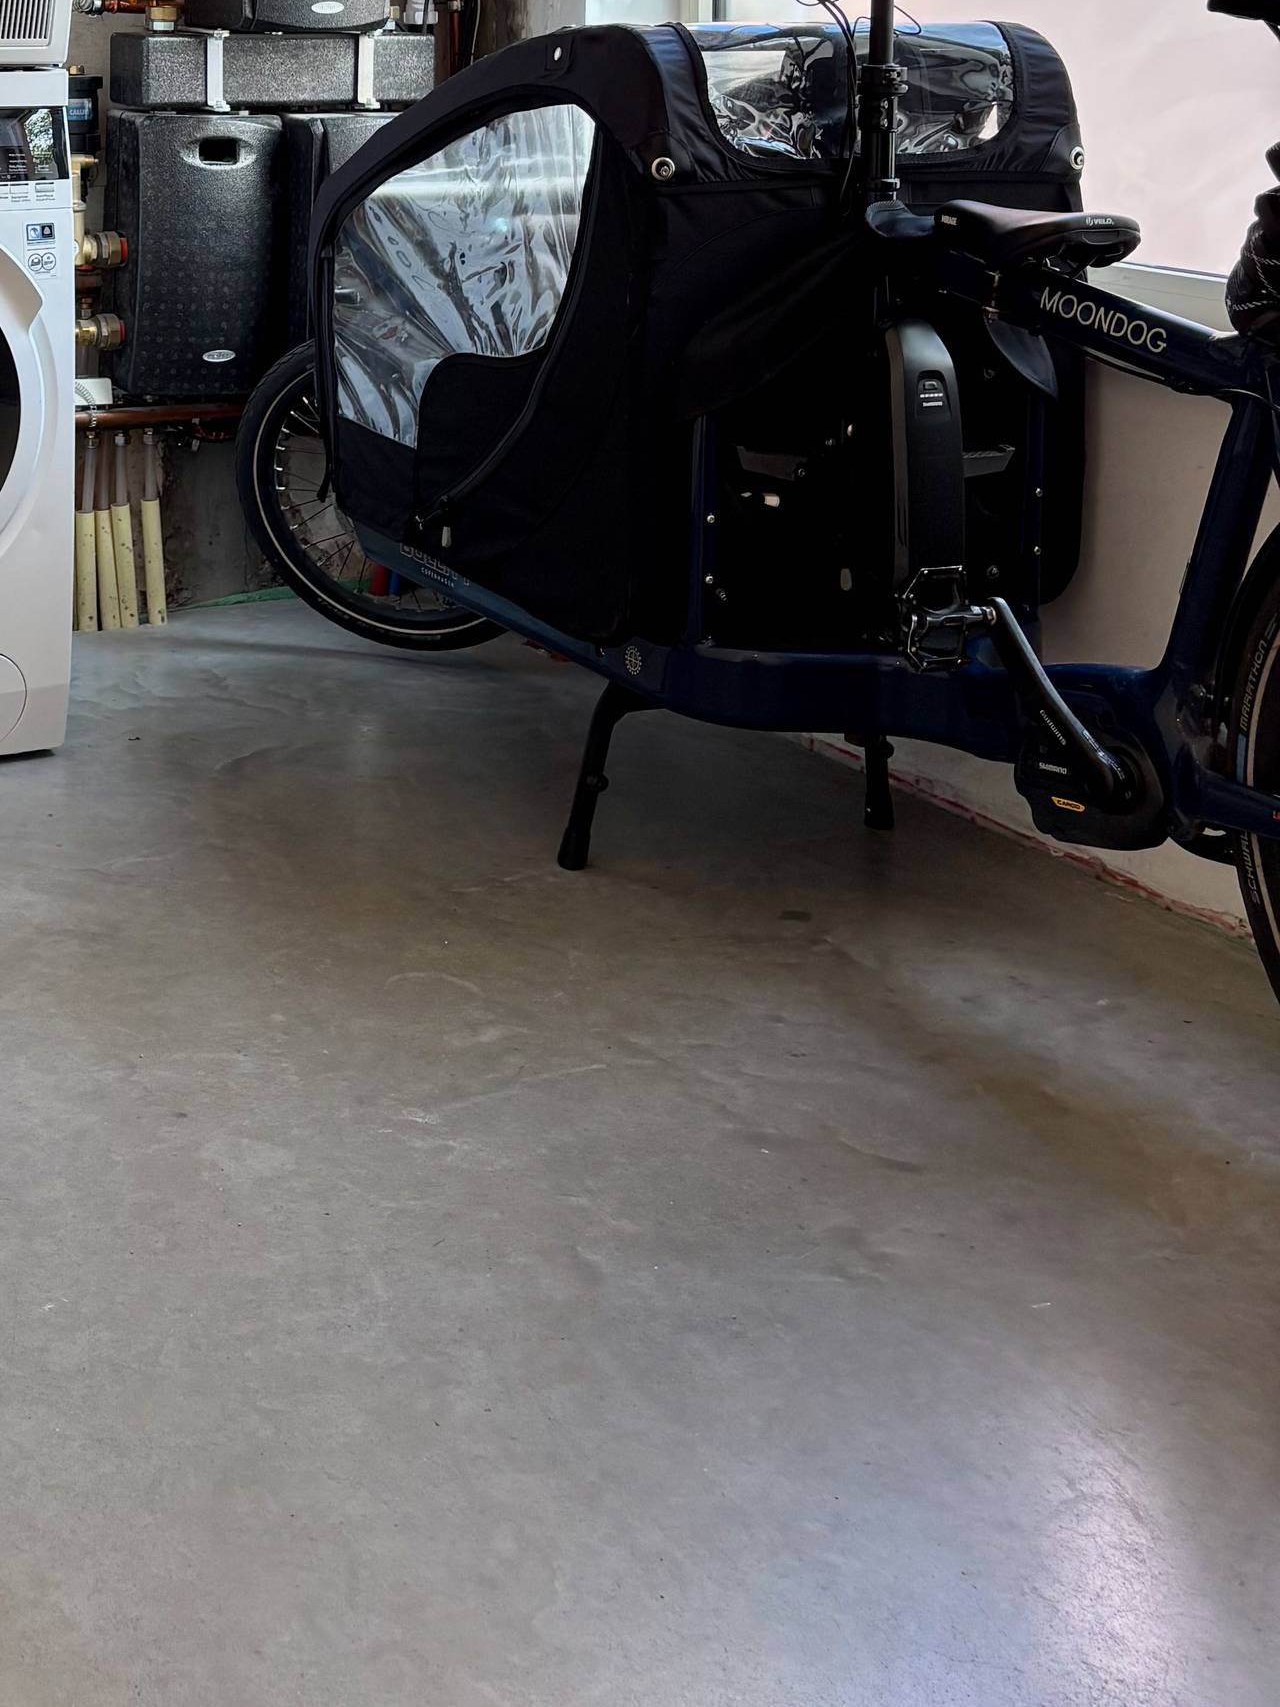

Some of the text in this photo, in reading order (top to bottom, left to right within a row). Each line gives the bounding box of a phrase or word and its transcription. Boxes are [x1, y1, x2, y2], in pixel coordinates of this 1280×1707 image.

[1040, 286, 1167, 354] MOONDOG
[1240, 640, 1268, 732] MARATHON
[1240, 830, 1261, 904] SCHWAL
